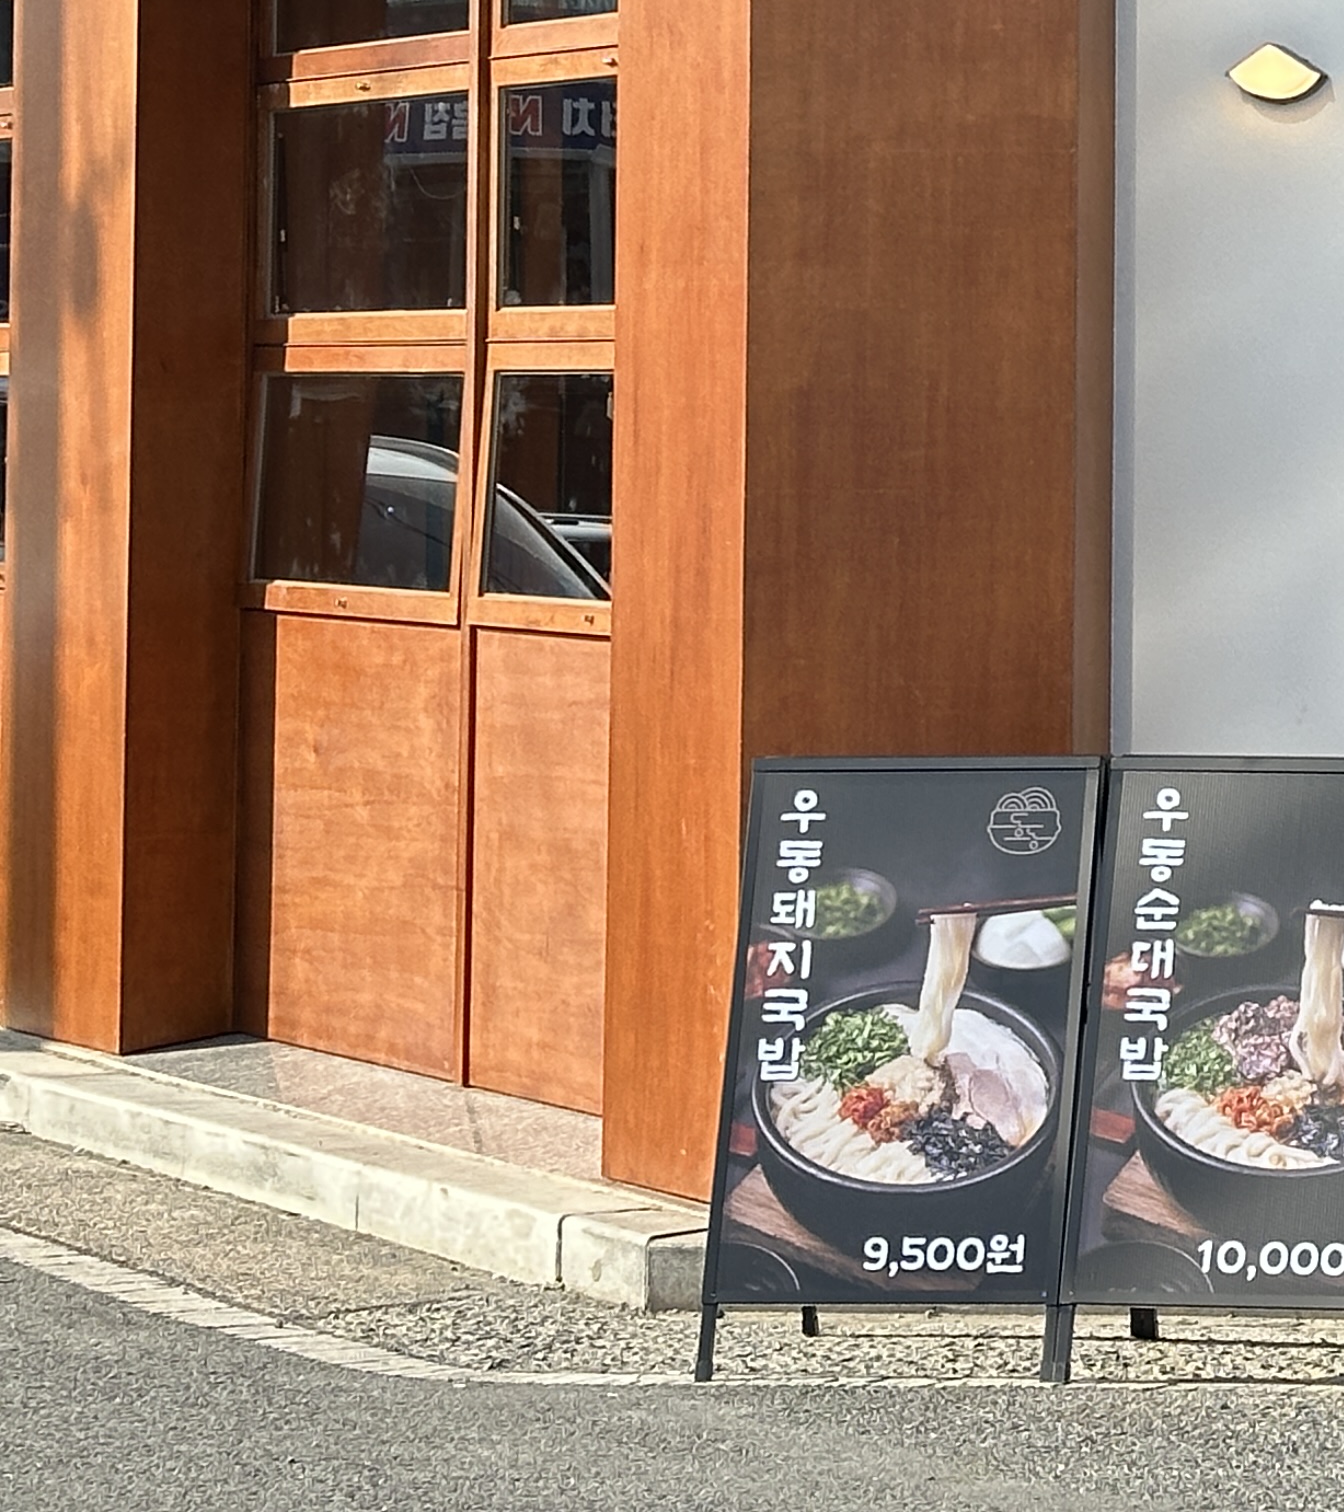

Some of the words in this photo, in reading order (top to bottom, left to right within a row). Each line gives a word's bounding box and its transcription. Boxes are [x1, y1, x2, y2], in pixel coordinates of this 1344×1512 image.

[756, 786, 828, 1083] 우동돼지국밥
[1118, 786, 1190, 1083] 우동순대국밥
[862, 1233, 1027, 1278] 9,500원
